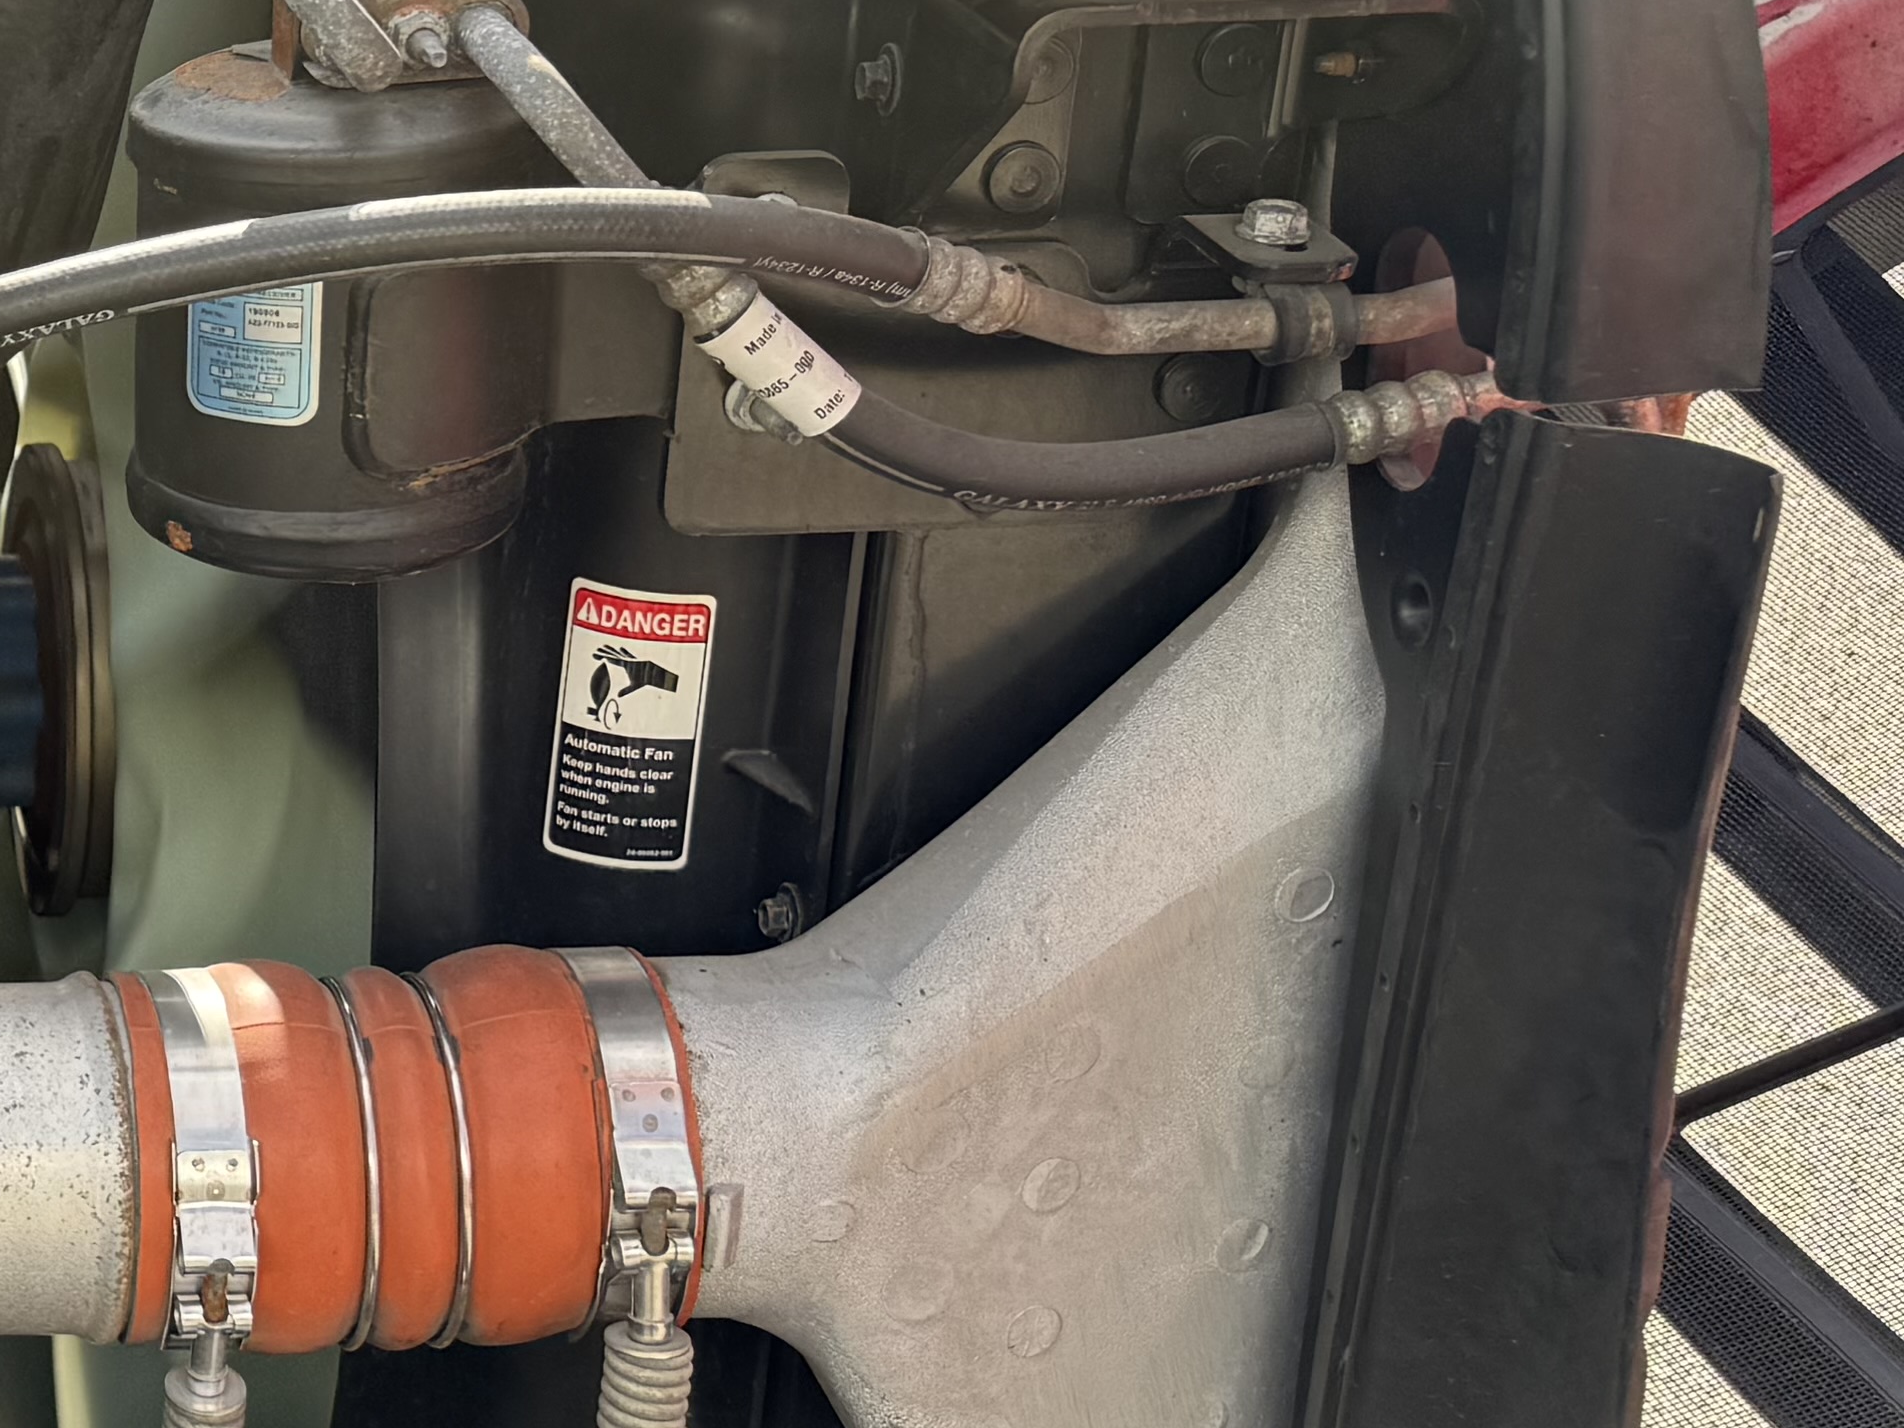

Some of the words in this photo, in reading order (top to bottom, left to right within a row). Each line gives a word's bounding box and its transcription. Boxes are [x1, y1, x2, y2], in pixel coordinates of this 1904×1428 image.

[0, 308, 116, 350] GALAXY
[744, 322, 778, 356] Made
[814, 389, 845, 421] Date:
[600, 605, 706, 638] DANGER
[565, 734, 641, 759] Automatic
[644, 748, 673, 761] Fan
[561, 769, 592, 784] when
[595, 777, 640, 793] engine
[643, 783, 655, 793] is
[563, 754, 593, 772] Keep
[596, 763, 636, 778] hands
[640, 769, 674, 780] clear
[559, 783, 609, 805] running.
[556, 815, 570, 830] by
[573, 819, 608, 837] itself.
[557, 801, 578, 816] Fan
[581, 809, 619, 824] starts
[623, 818, 638, 826] or
[640, 818, 677, 830] stops
